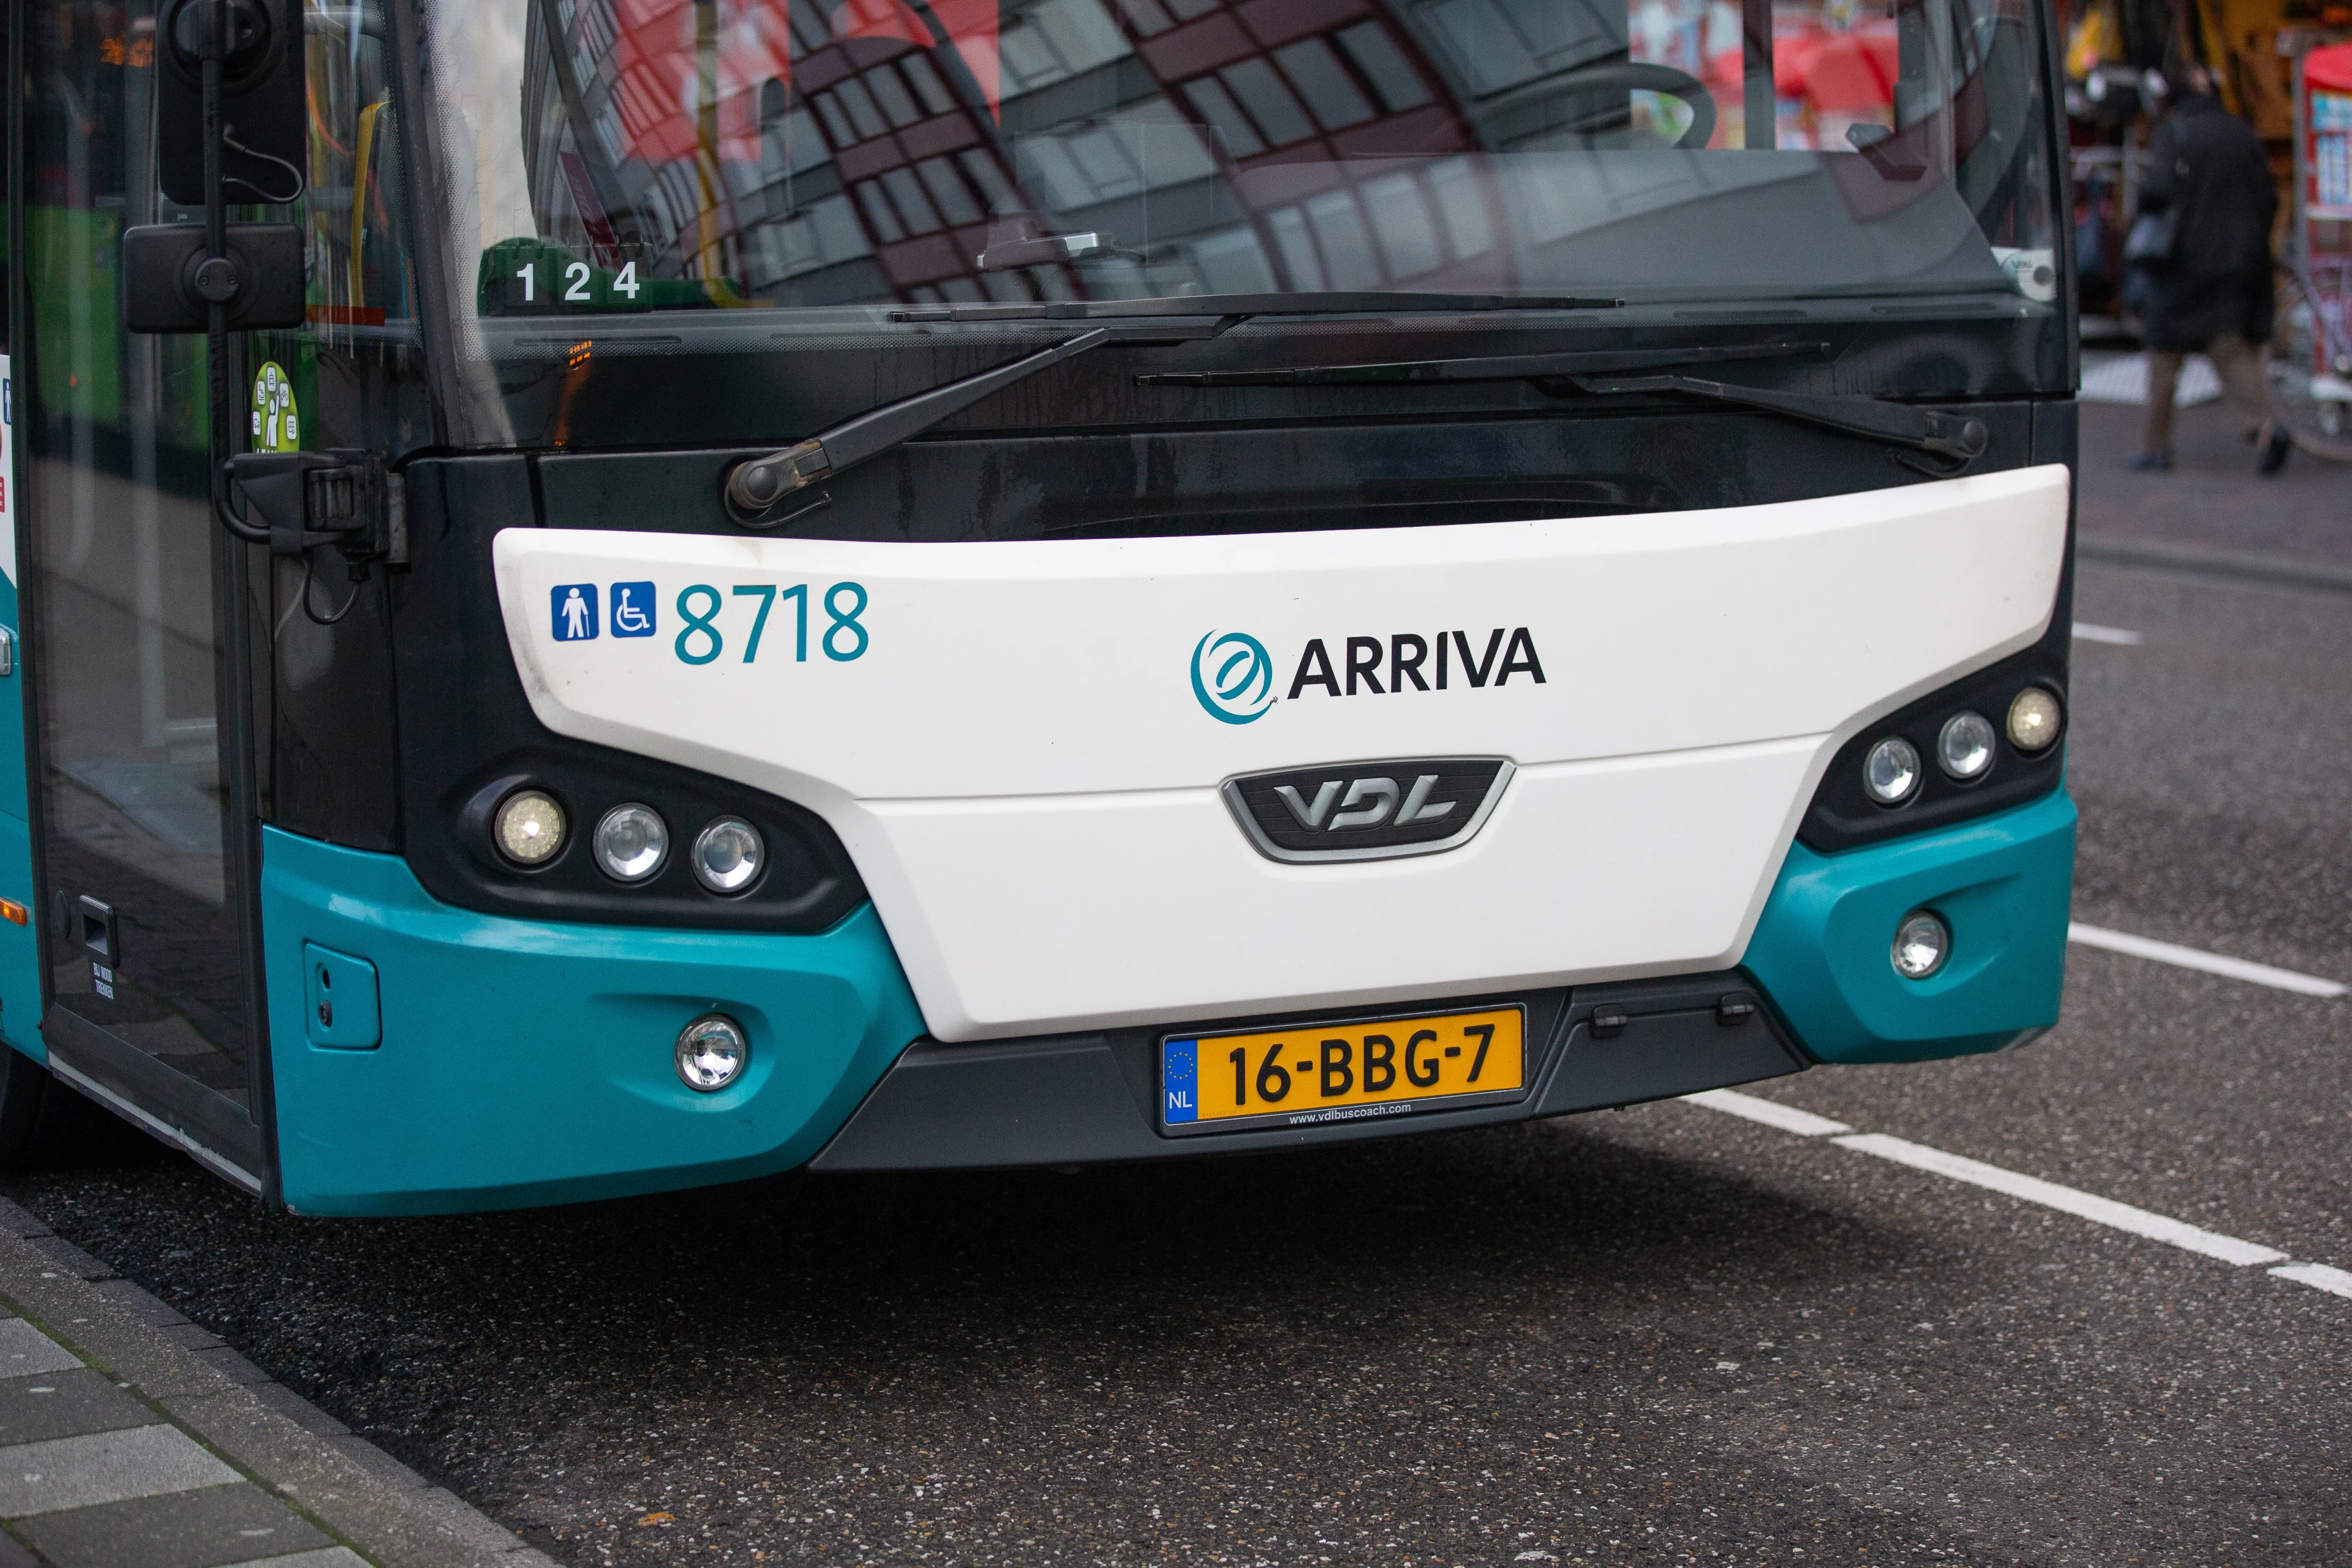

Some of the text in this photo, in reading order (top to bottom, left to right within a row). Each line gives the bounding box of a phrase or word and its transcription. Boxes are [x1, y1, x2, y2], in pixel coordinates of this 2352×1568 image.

[674, 581, 869, 666] 8718
[1287, 627, 1547, 699] ARRIVA
[1273, 774, 1457, 832] VDL
[95, 979, 114, 1000] TREKKEN
[100, 965, 113, 983] NOOD
[1229, 1023, 1495, 1106] 16-BBG-7
[1169, 1090, 1193, 1109] NL
[1289, 1104, 1411, 1125] www.vdlbuscoach.com
